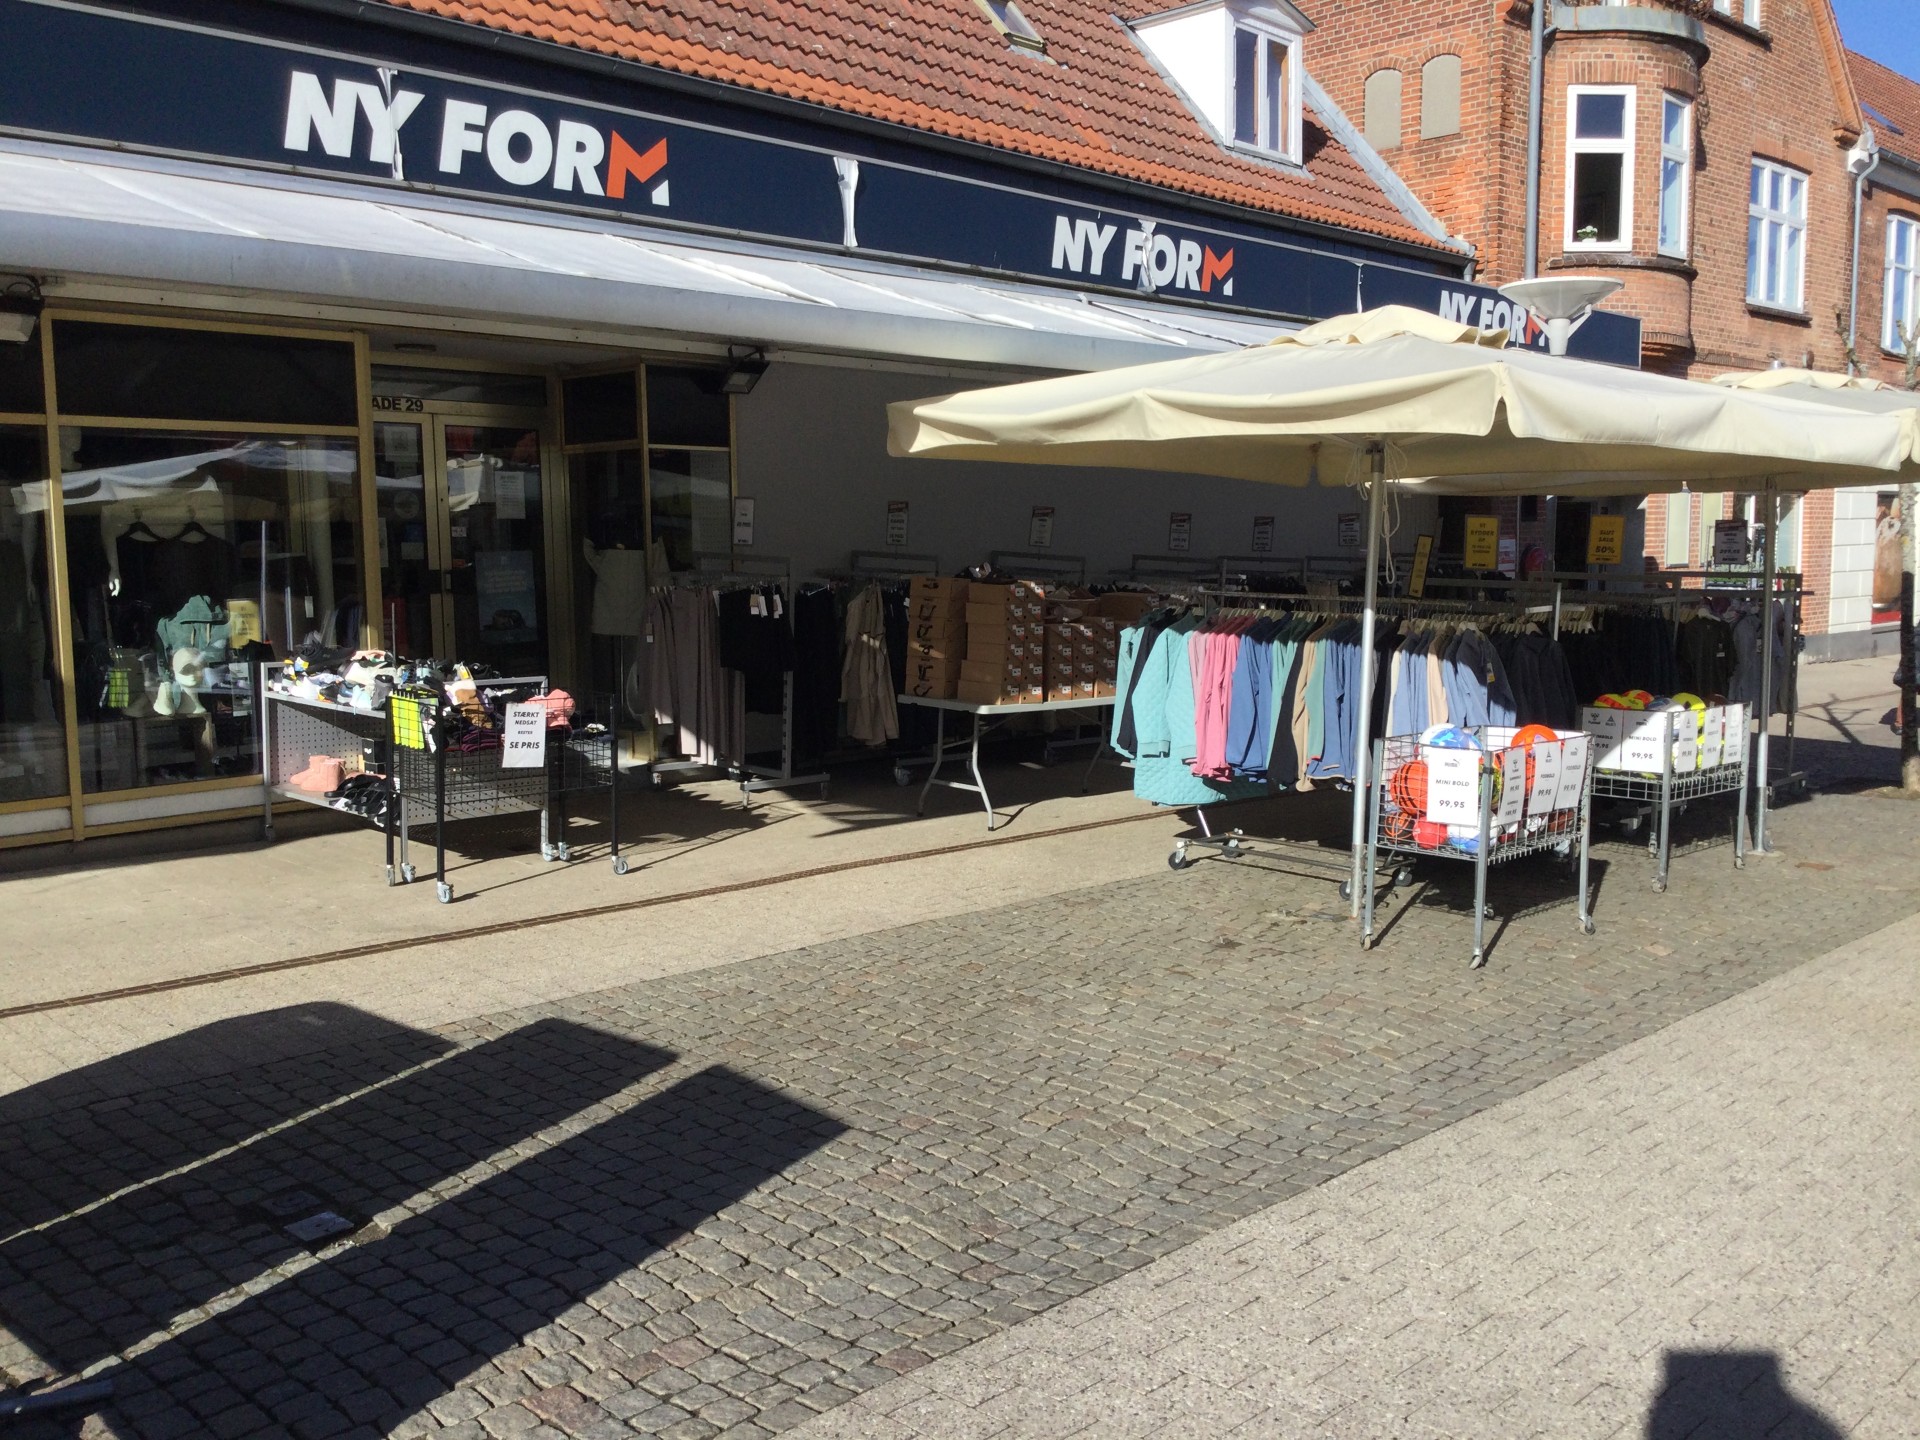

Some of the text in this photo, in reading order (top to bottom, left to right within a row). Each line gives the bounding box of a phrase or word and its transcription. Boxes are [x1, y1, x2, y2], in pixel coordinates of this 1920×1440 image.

[284, 71, 670, 207] NY FORM
[1052, 215, 1234, 296] NY FORM
[1439, 290, 1477, 326] NY
[405, 398, 424, 412] 29
[1595, 545, 1616, 554] 50%
[509, 741, 540, 749] SE PRIS
[1631, 752, 1653, 760] 99,95
[1537, 788, 1552, 797] 99,95
[1439, 799, 1465, 809] 99,95
